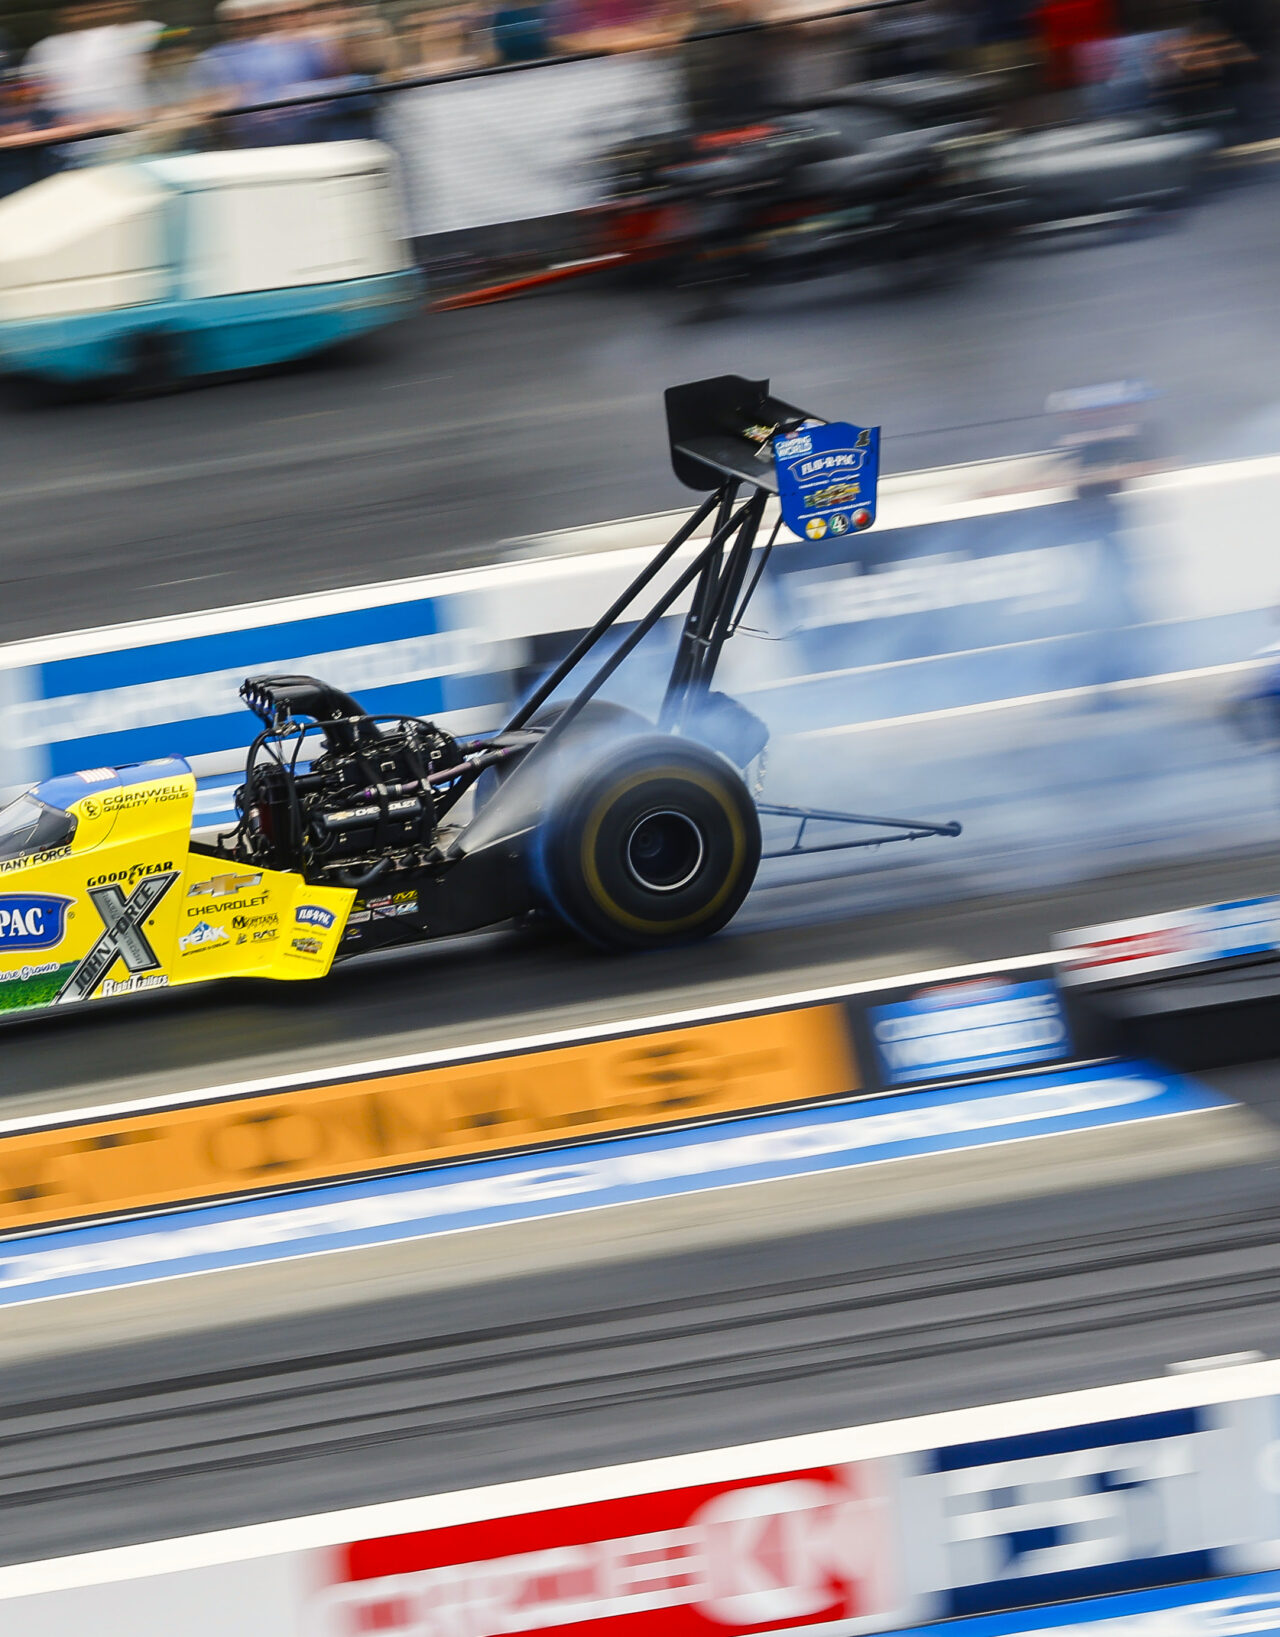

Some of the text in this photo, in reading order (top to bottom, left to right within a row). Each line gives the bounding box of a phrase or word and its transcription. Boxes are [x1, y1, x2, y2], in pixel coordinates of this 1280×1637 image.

[102, 785, 189, 806] CORNWELL
[102, 791, 189, 813] QUALITY TOOLS
[32, 845, 73, 866] FORCE
[187, 895, 269, 918] CHEVROLET
[178, 925, 231, 951] PEAK
[21, 963, 58, 980] Grown
